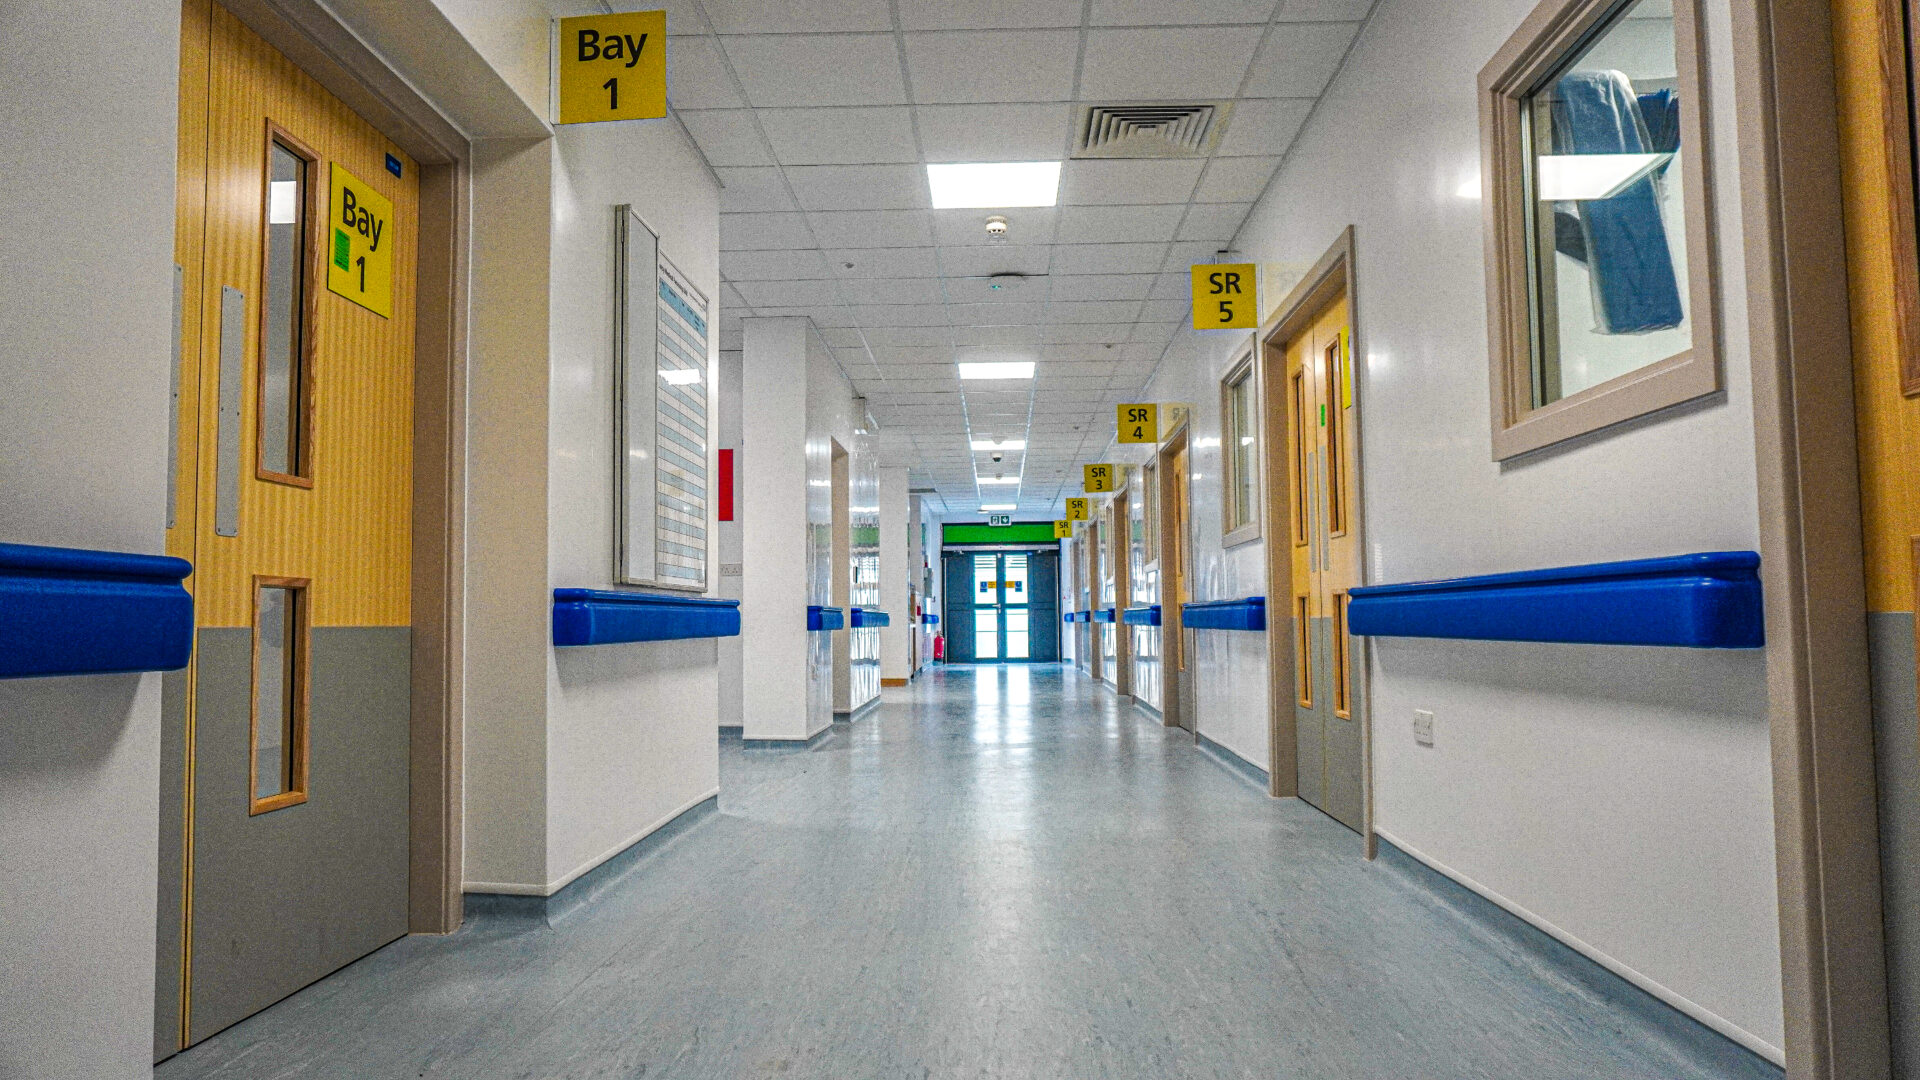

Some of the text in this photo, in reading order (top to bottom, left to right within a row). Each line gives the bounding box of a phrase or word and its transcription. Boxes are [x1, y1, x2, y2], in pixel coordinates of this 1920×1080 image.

[577, 28, 648, 69] Bay
[602, 78, 618, 111] 1
[342, 186, 384, 252] Bay
[356, 255, 366, 293] 1
[1210, 272, 1242, 295] SR
[1220, 300, 1234, 323] 5
[1128, 408, 1148, 423] SR
[1133, 426, 1144, 440] 4
[1091, 467, 1106, 478] SR
[1095, 479, 1103, 490] 3
[1071, 500, 1083, 509] SR
[1074, 510, 1081, 519] 2
[1059, 521, 1069, 529] SR
